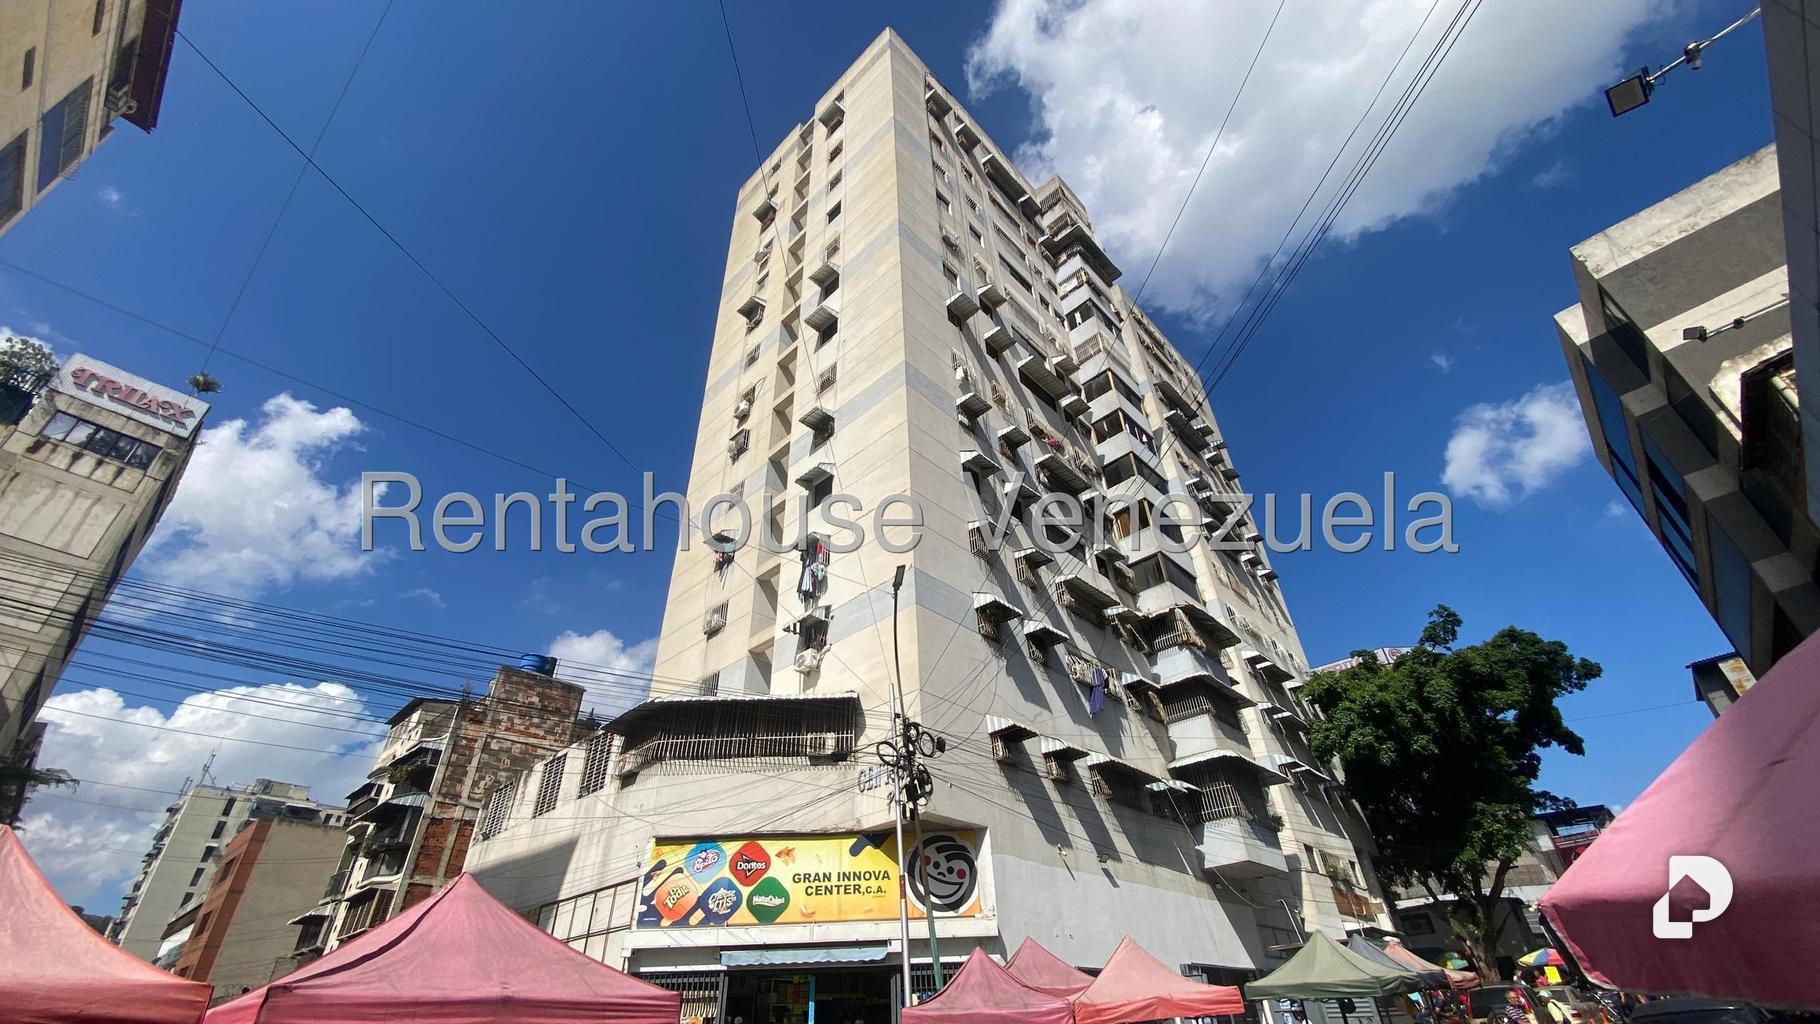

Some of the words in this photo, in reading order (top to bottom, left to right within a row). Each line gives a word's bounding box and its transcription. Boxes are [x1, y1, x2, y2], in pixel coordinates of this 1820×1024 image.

[736, 861, 766, 871] Doritos
[792, 872, 832, 884] GRAN
[837, 870, 890, 882] INNOVA
